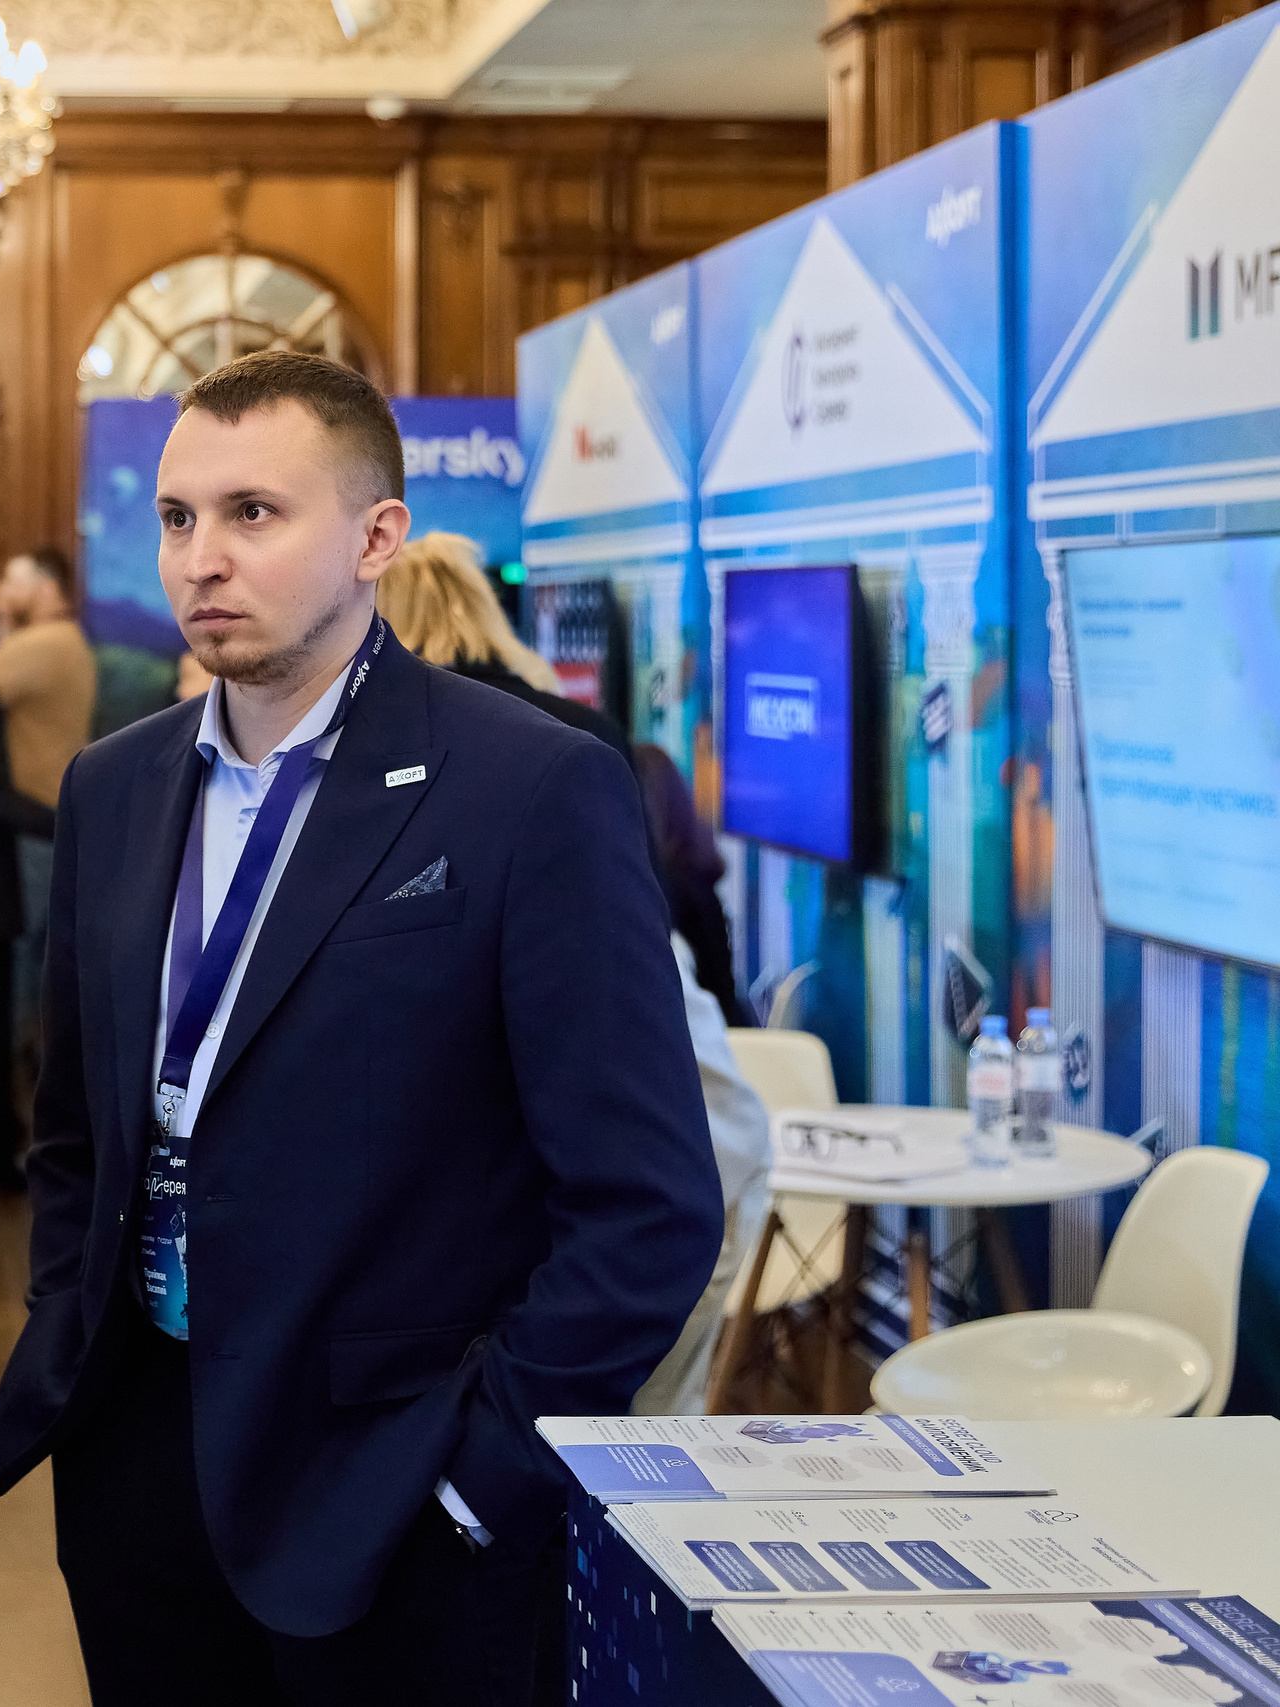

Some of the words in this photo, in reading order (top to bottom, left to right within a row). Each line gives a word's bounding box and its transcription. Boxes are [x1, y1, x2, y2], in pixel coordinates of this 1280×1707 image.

[401, 427, 525, 487] ersky
[349, 660, 370, 699] AXOFT
[388, 768, 423, 784] AXOFT
[939, 1418, 978, 1441] SECRET
[966, 1441, 1002, 1464] CLOUD
[1210, 1601, 1270, 1636] SECRET
